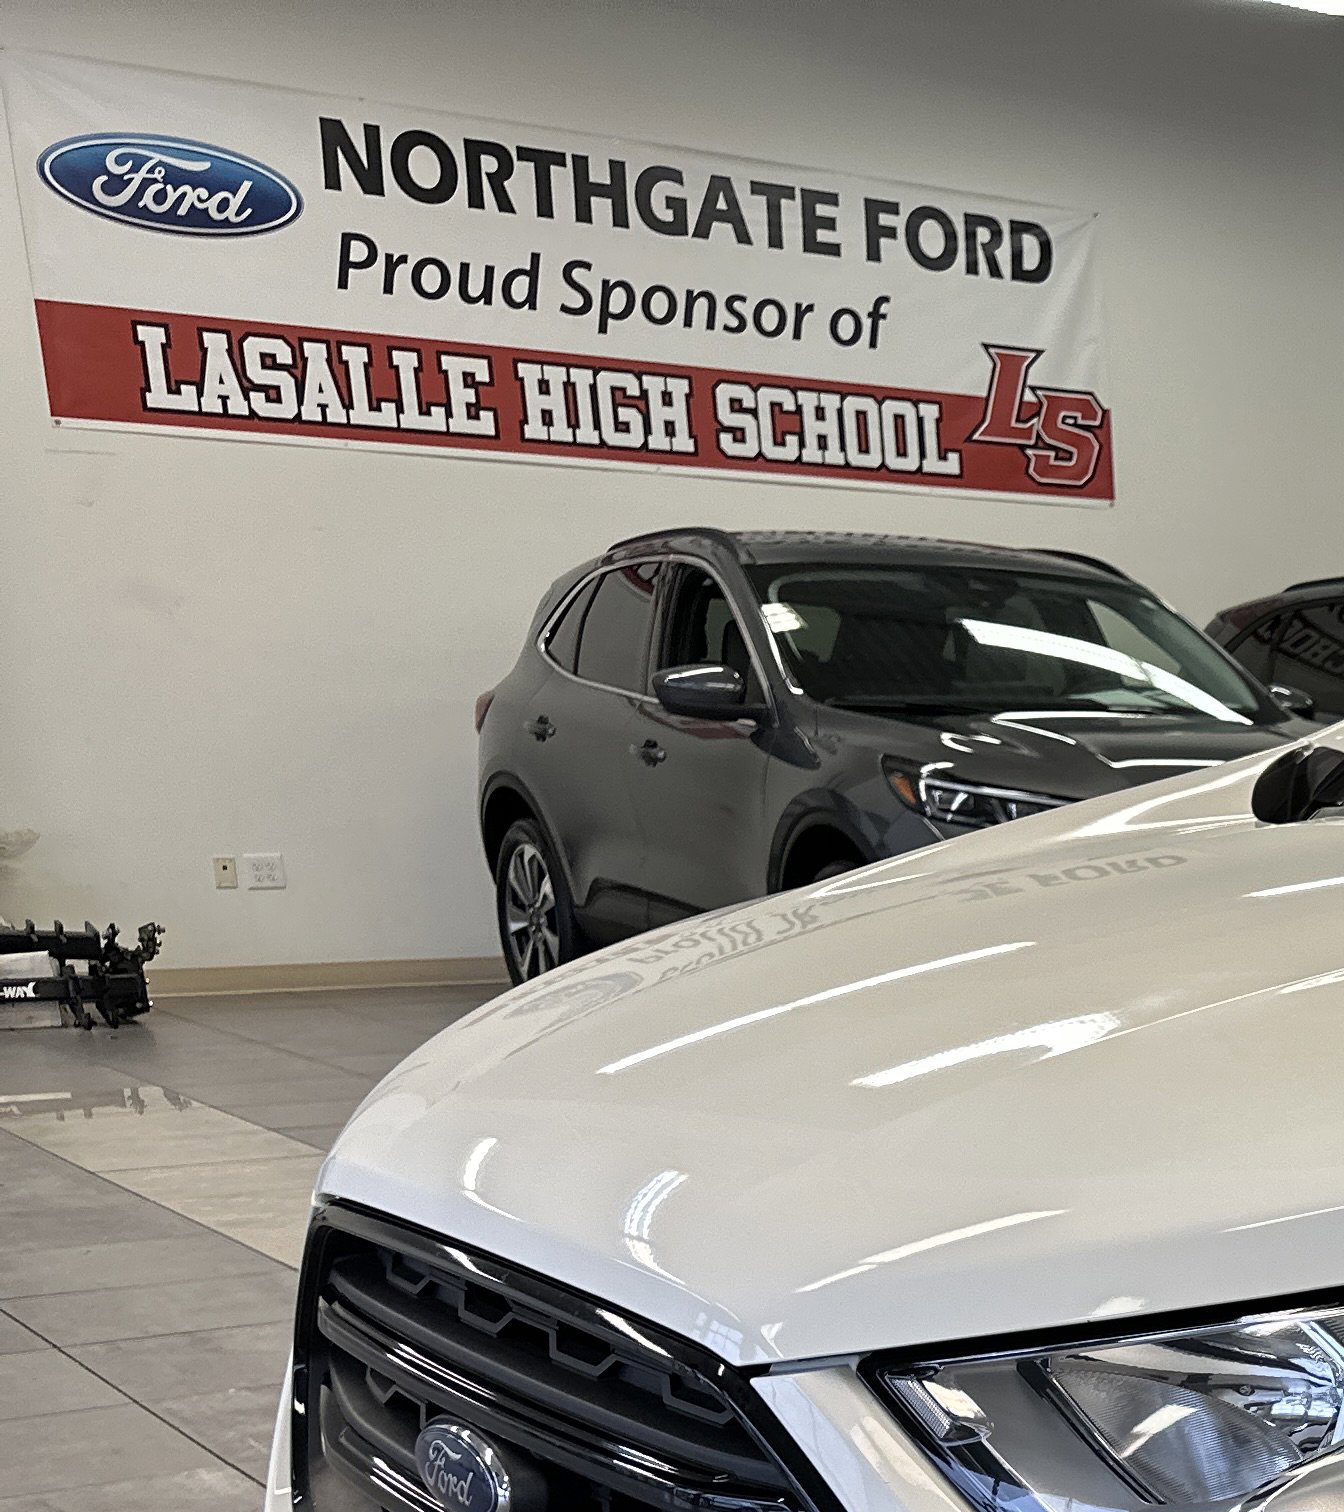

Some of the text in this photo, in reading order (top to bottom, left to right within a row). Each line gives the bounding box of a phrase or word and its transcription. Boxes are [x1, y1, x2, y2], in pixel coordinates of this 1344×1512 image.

[92, 147, 254, 224] Ford
[318, 116, 1054, 284] NORTHGATE FORD
[336, 231, 889, 350] Proud Sponsor of
[133, 321, 963, 477] LASALLE HIGH SCHOOL
[967, 343, 1109, 487] LS
[425, 1439, 474, 1506] Ford
